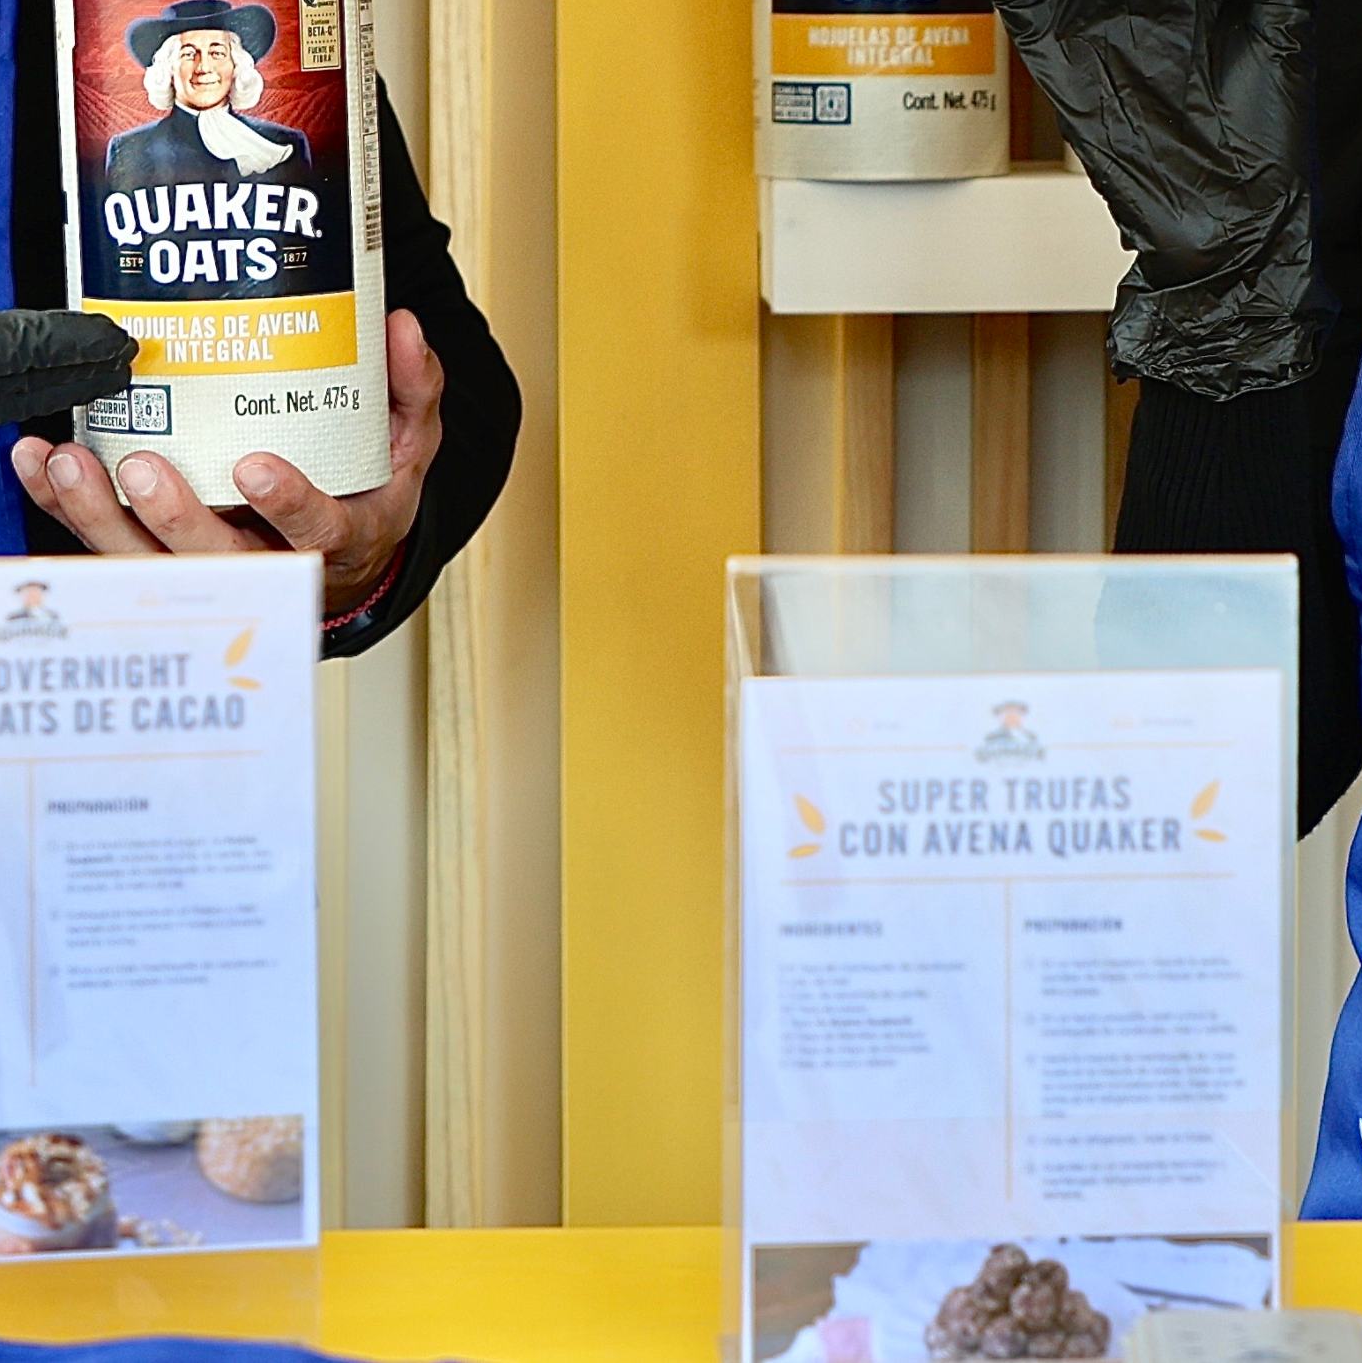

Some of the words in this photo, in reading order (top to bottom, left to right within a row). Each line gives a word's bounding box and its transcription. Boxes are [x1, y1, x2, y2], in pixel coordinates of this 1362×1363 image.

[903, 91, 936, 111] Cont.
[943, 92, 966, 111] Net.
[104, 183, 318, 247] QUAKER
[149, 237, 278, 284] OATS
[282, 252, 307, 263] 1877
[121, 316, 216, 340] HOJUELAS
[224, 314, 250, 337] DE
[257, 310, 320, 336] AVENA
[165, 338, 273, 363] INTEGRAL
[234, 394, 280, 416] Cont.
[287, 391, 319, 413] Net.
[323, 386, 349, 409] 475
[352, 388, 360, 410] g
[74, 698, 116, 734] DE
[131, 693, 246, 731] CACAO
[877, 779, 989, 815] SUPER
[1006, 776, 1132, 813] TRUFAS
[839, 822, 908, 857] CON
[922, 820, 1034, 855] AVENA
[1047, 817, 1182, 858] QUAKER
